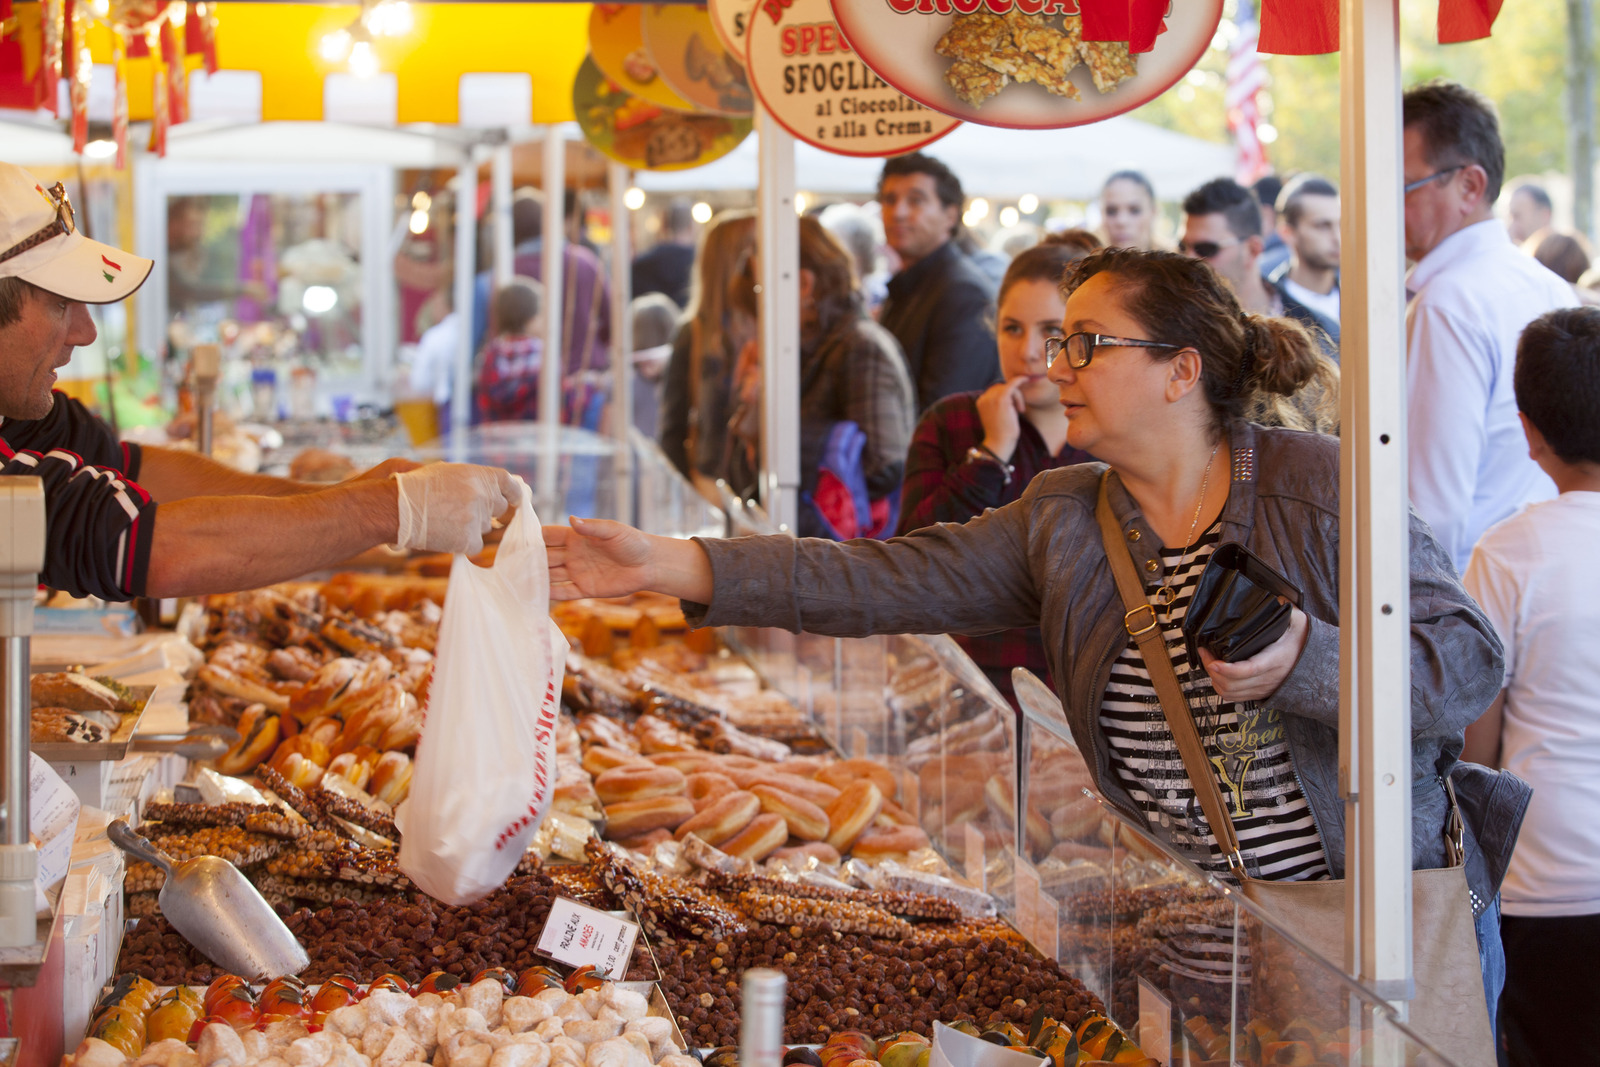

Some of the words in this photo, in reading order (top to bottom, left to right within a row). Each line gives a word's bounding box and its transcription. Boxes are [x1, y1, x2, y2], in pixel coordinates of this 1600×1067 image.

[815, 98, 833, 116] al
[840, 92, 931, 115] Cioccola
[817, 126, 826, 139] e
[832, 120, 867, 138] alla
[874, 117, 932, 136] Crema
